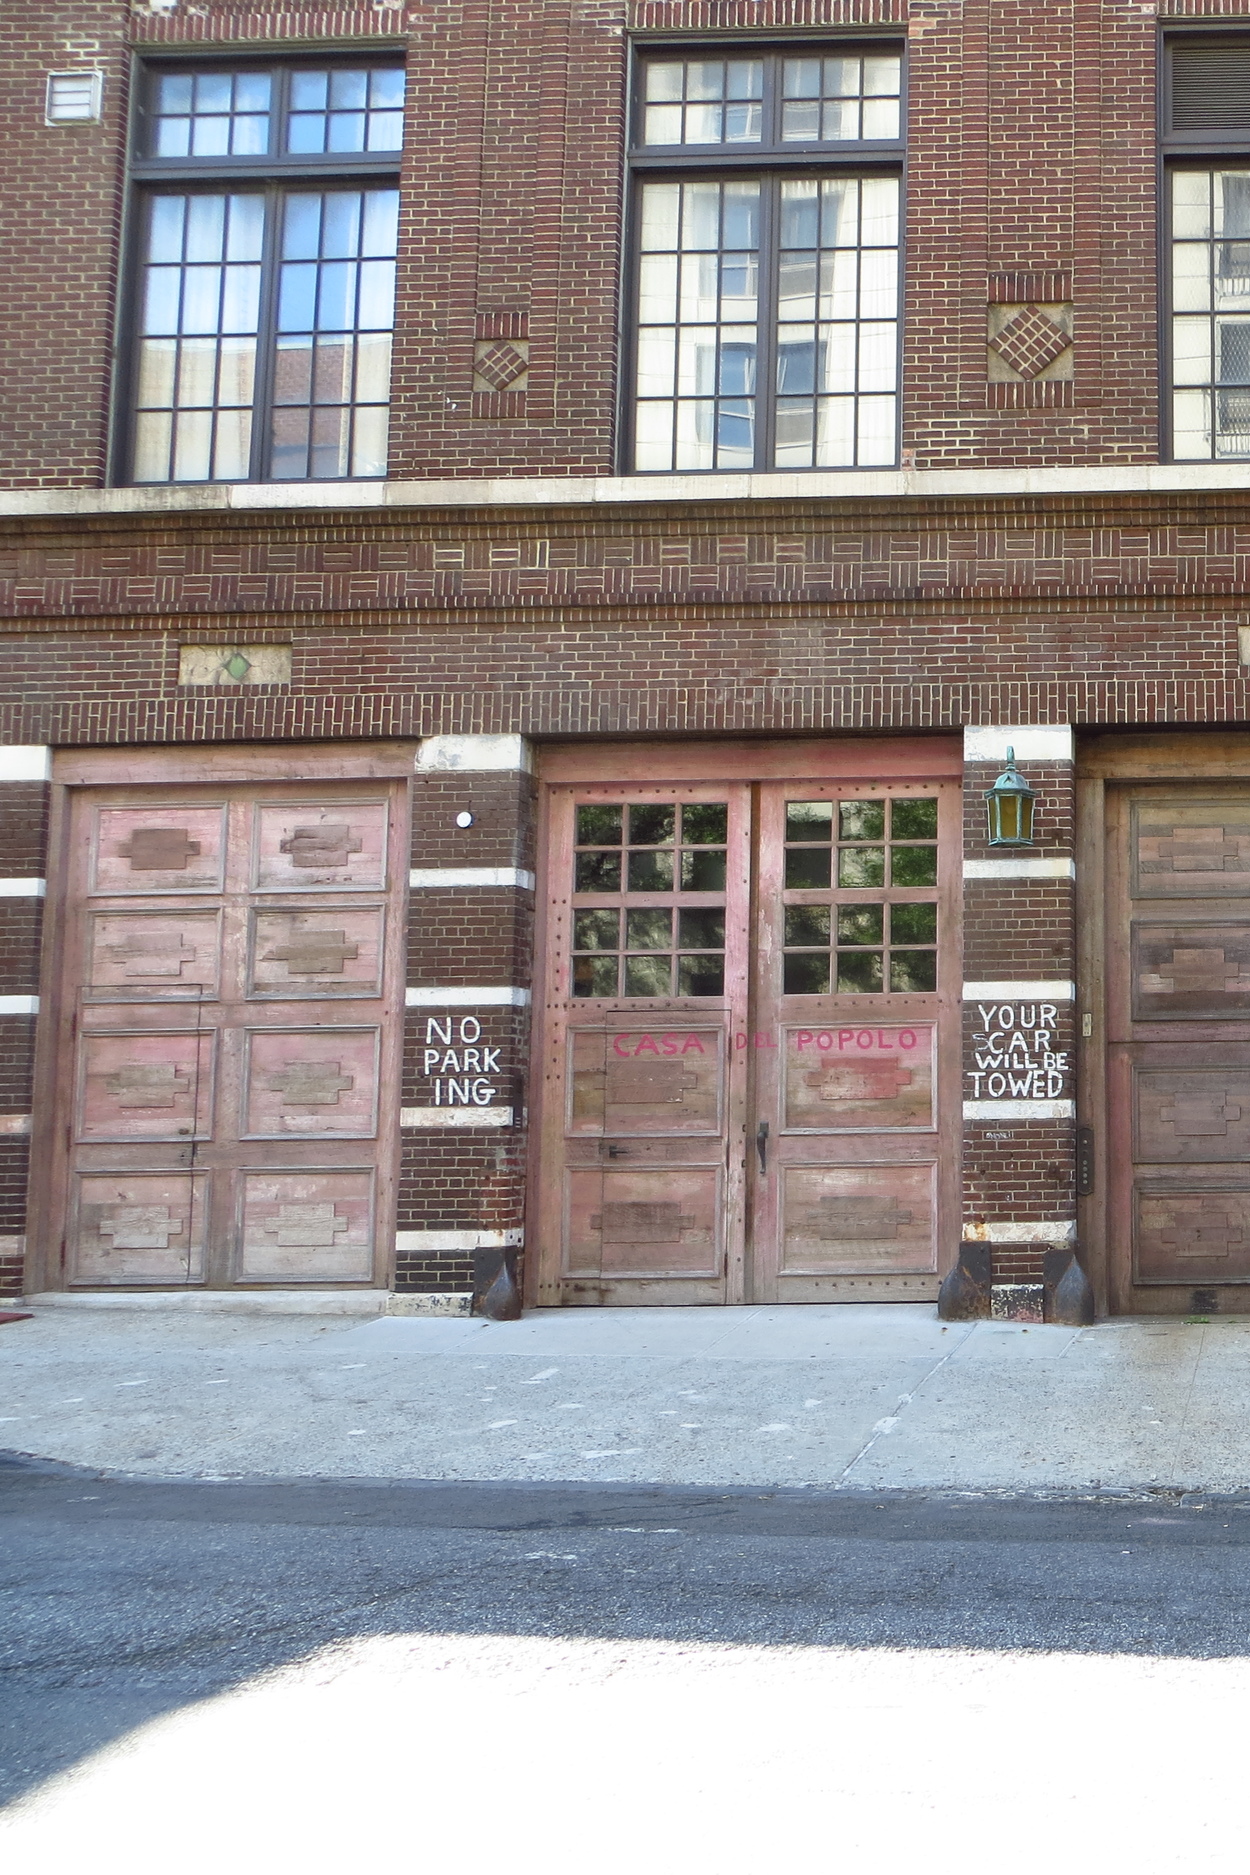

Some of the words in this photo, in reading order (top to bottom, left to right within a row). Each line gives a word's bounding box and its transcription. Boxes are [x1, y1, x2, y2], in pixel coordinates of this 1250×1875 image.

[425, 1016, 481, 1045] NO
[977, 1004, 1057, 1033] YOUR
[613, 1032, 705, 1058] CASA
[735, 1031, 778, 1050] DEL
[797, 1029, 918, 1052] POPOLO
[424, 1047, 502, 1075] PARK
[974, 1052, 1039, 1070] WILL
[1043, 1051, 1070, 1071] BE
[434, 1078, 497, 1107] ING
[966, 1070, 1064, 1098] TOWED
